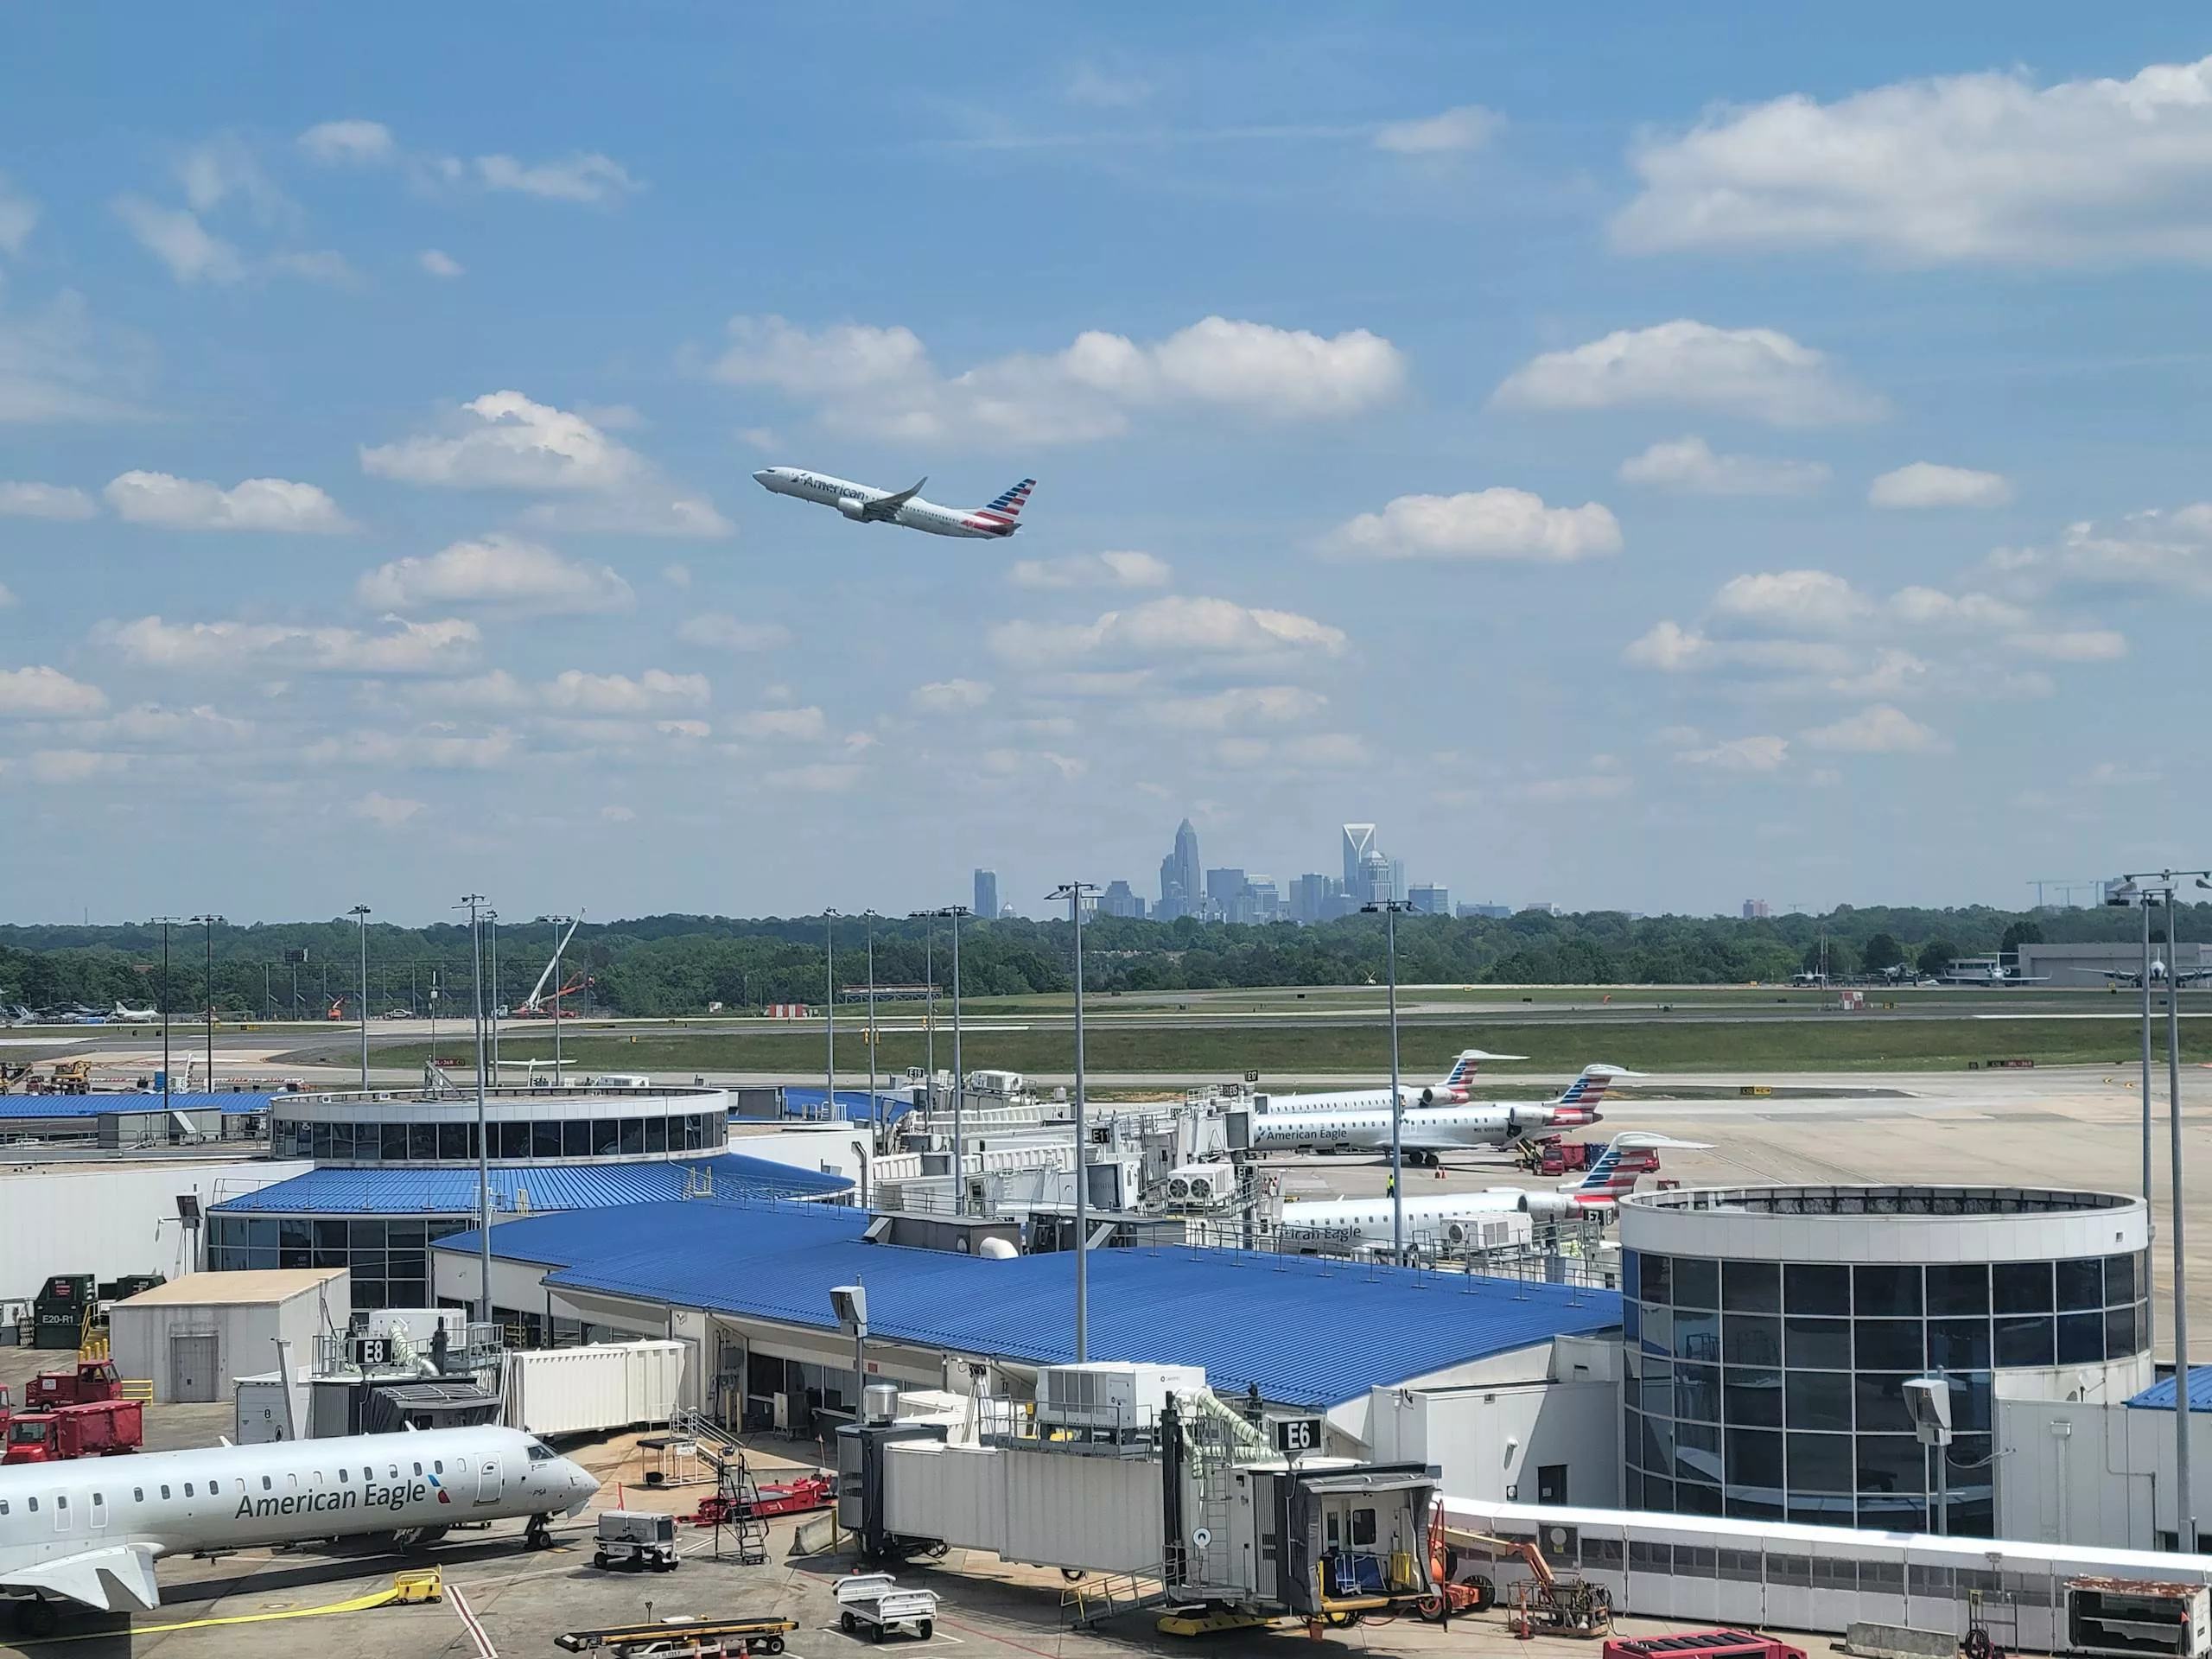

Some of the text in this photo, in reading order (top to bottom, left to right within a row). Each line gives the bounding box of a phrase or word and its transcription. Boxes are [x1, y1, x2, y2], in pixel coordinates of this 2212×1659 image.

[804, 476, 865, 500] American
[909, 1069, 922, 1077] E19
[1248, 1071, 1257, 1080] E17
[1092, 1130, 1109, 1142] E11
[1267, 1128, 1347, 1141] American Eagle
[1324, 1225, 1362, 1243] Eagle
[42, 1315, 73, 1324] E20-R1
[364, 1340, 384, 1363] E8
[1287, 1422, 1310, 1449] E6
[235, 1479, 426, 1519] American Eagle
